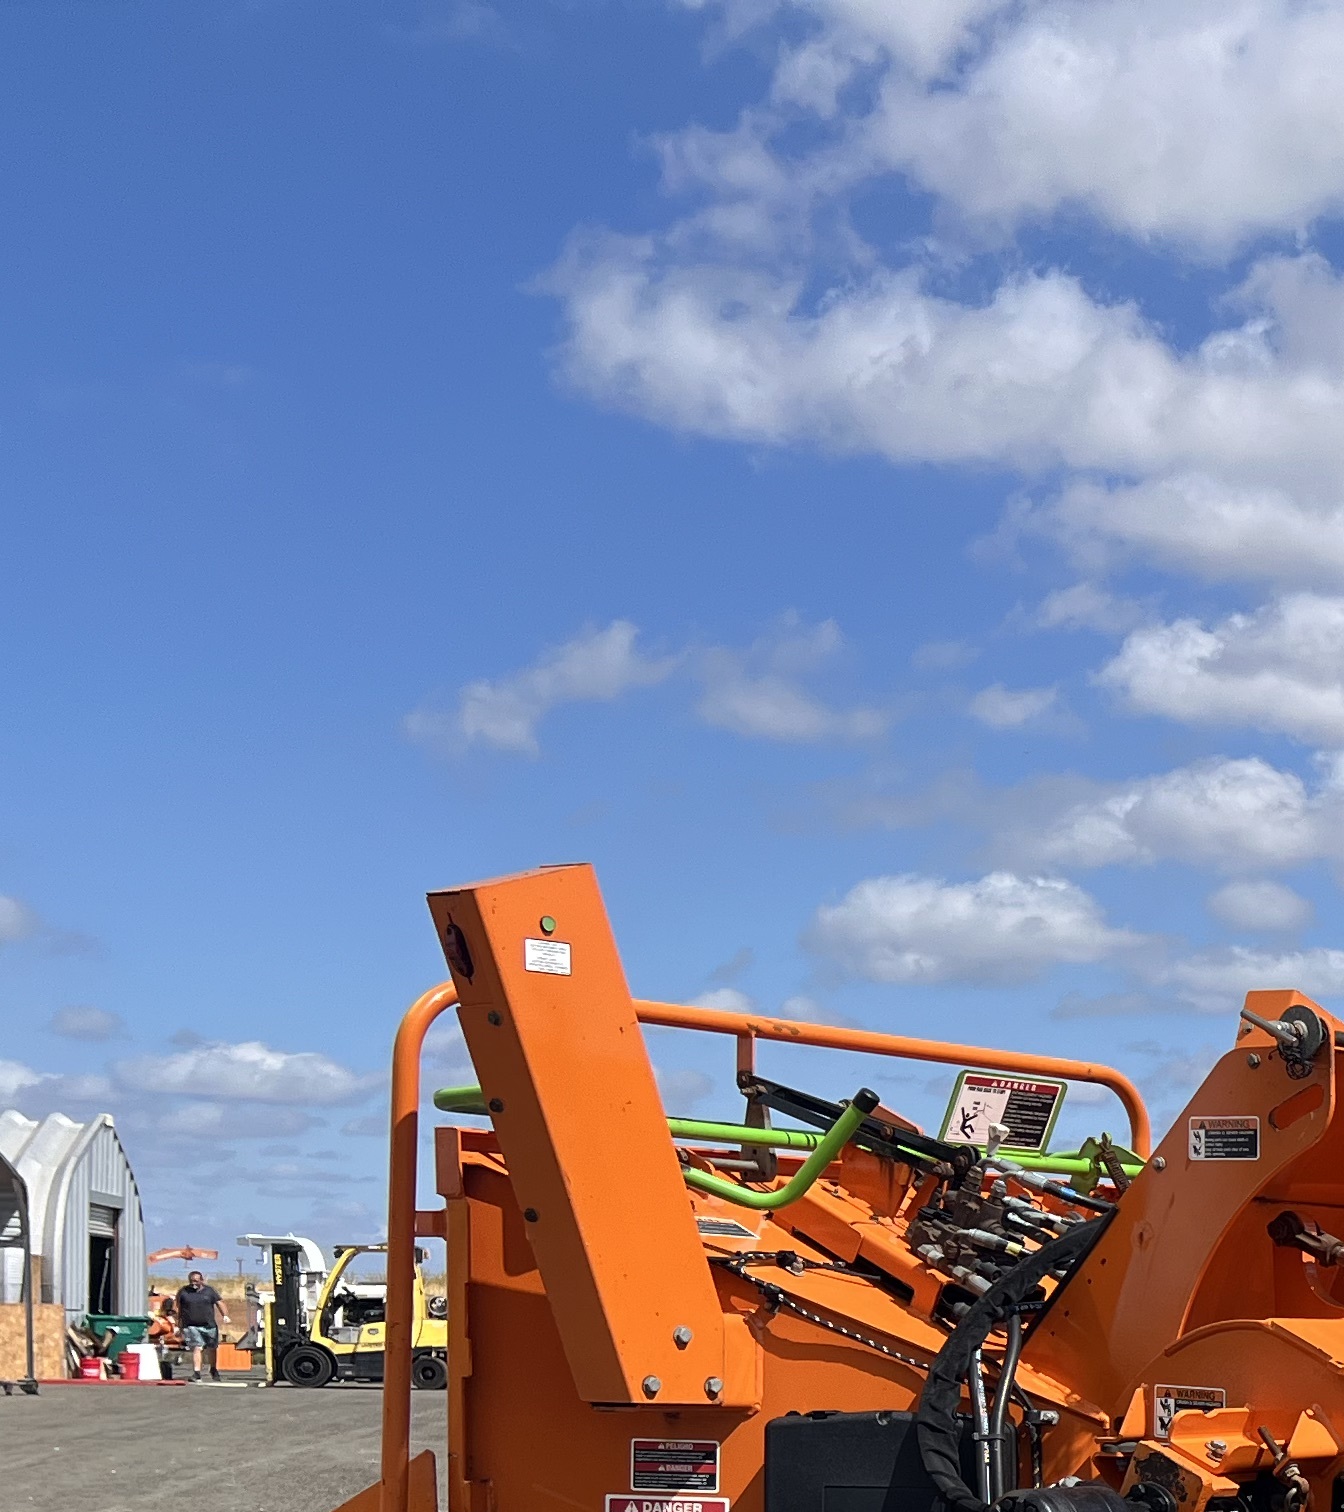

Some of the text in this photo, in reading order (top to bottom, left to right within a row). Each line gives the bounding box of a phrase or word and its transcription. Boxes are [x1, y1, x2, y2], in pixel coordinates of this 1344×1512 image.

[1000, 1080, 1036, 1092] DANGER
[1208, 1120, 1250, 1129] WARNING
[1177, 1389, 1215, 1400] WARNING
